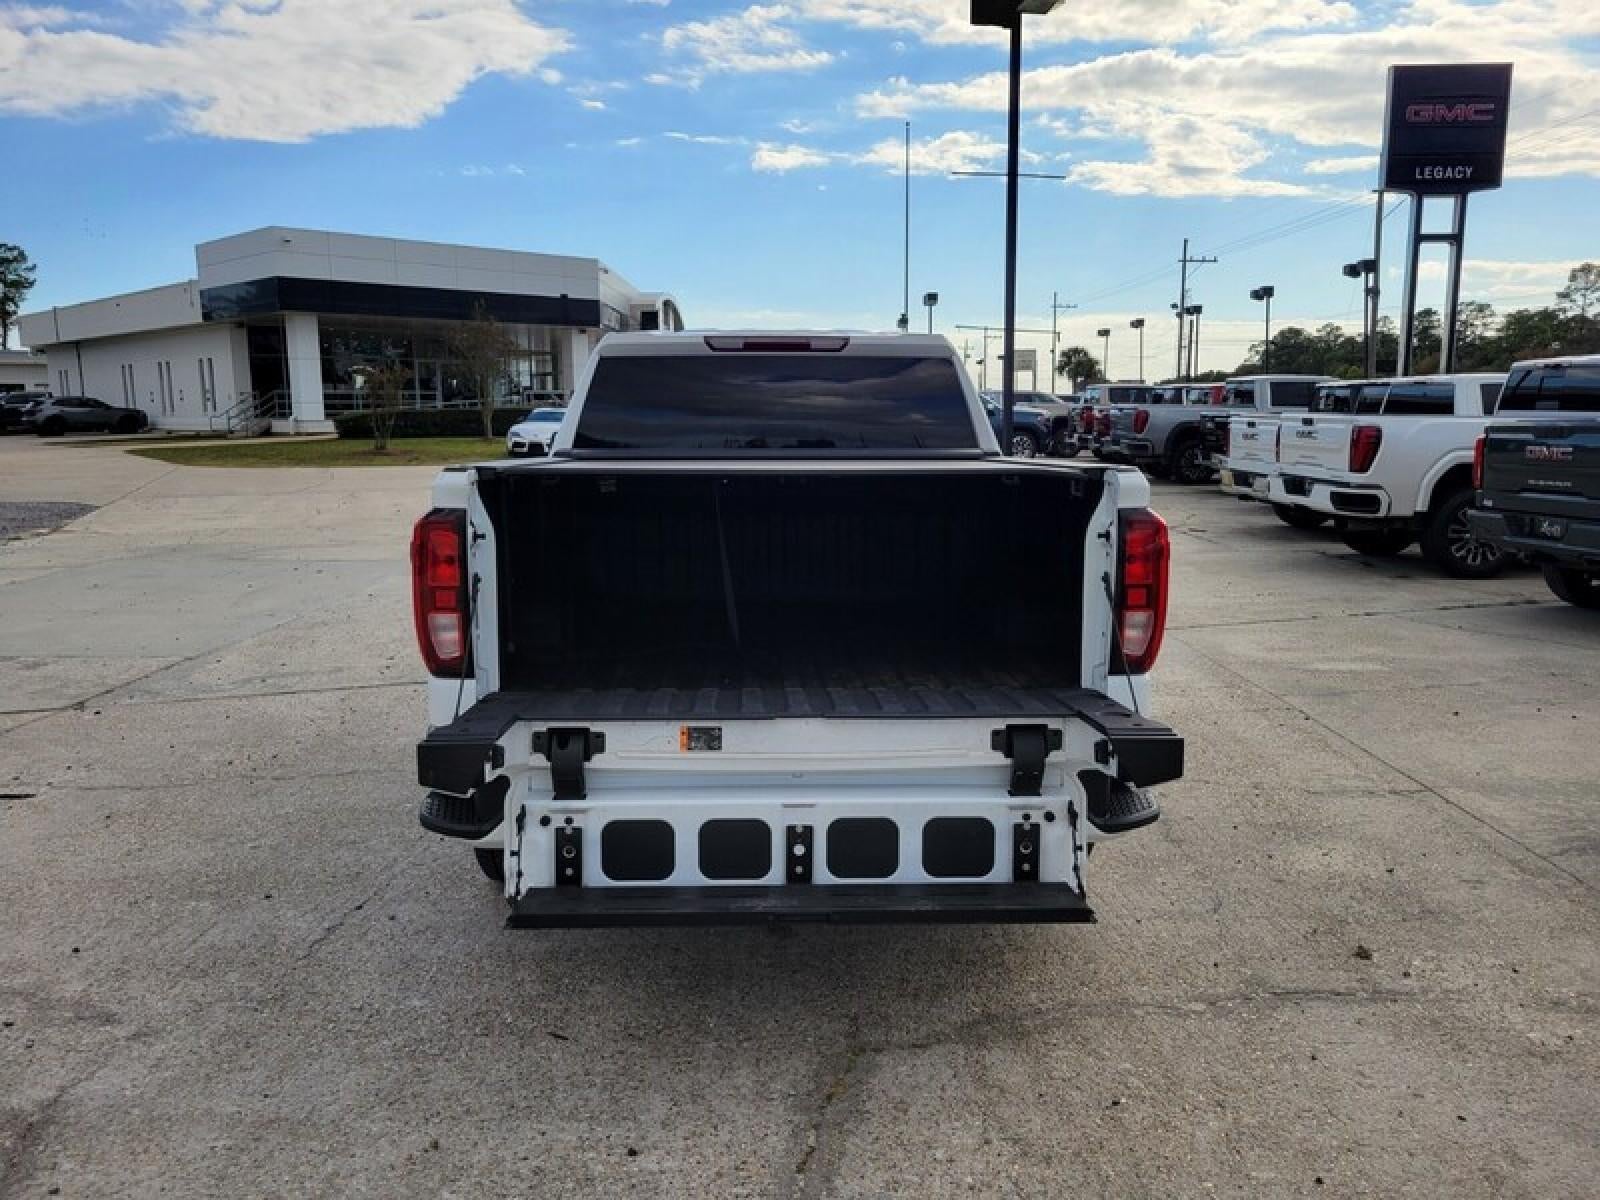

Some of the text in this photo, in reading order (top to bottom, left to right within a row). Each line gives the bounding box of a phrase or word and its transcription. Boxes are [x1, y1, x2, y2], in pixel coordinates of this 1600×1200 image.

[1405, 103, 1495, 123] GMC
[1415, 166, 1473, 179] LEGACY
[1526, 445, 1573, 461] GMC
